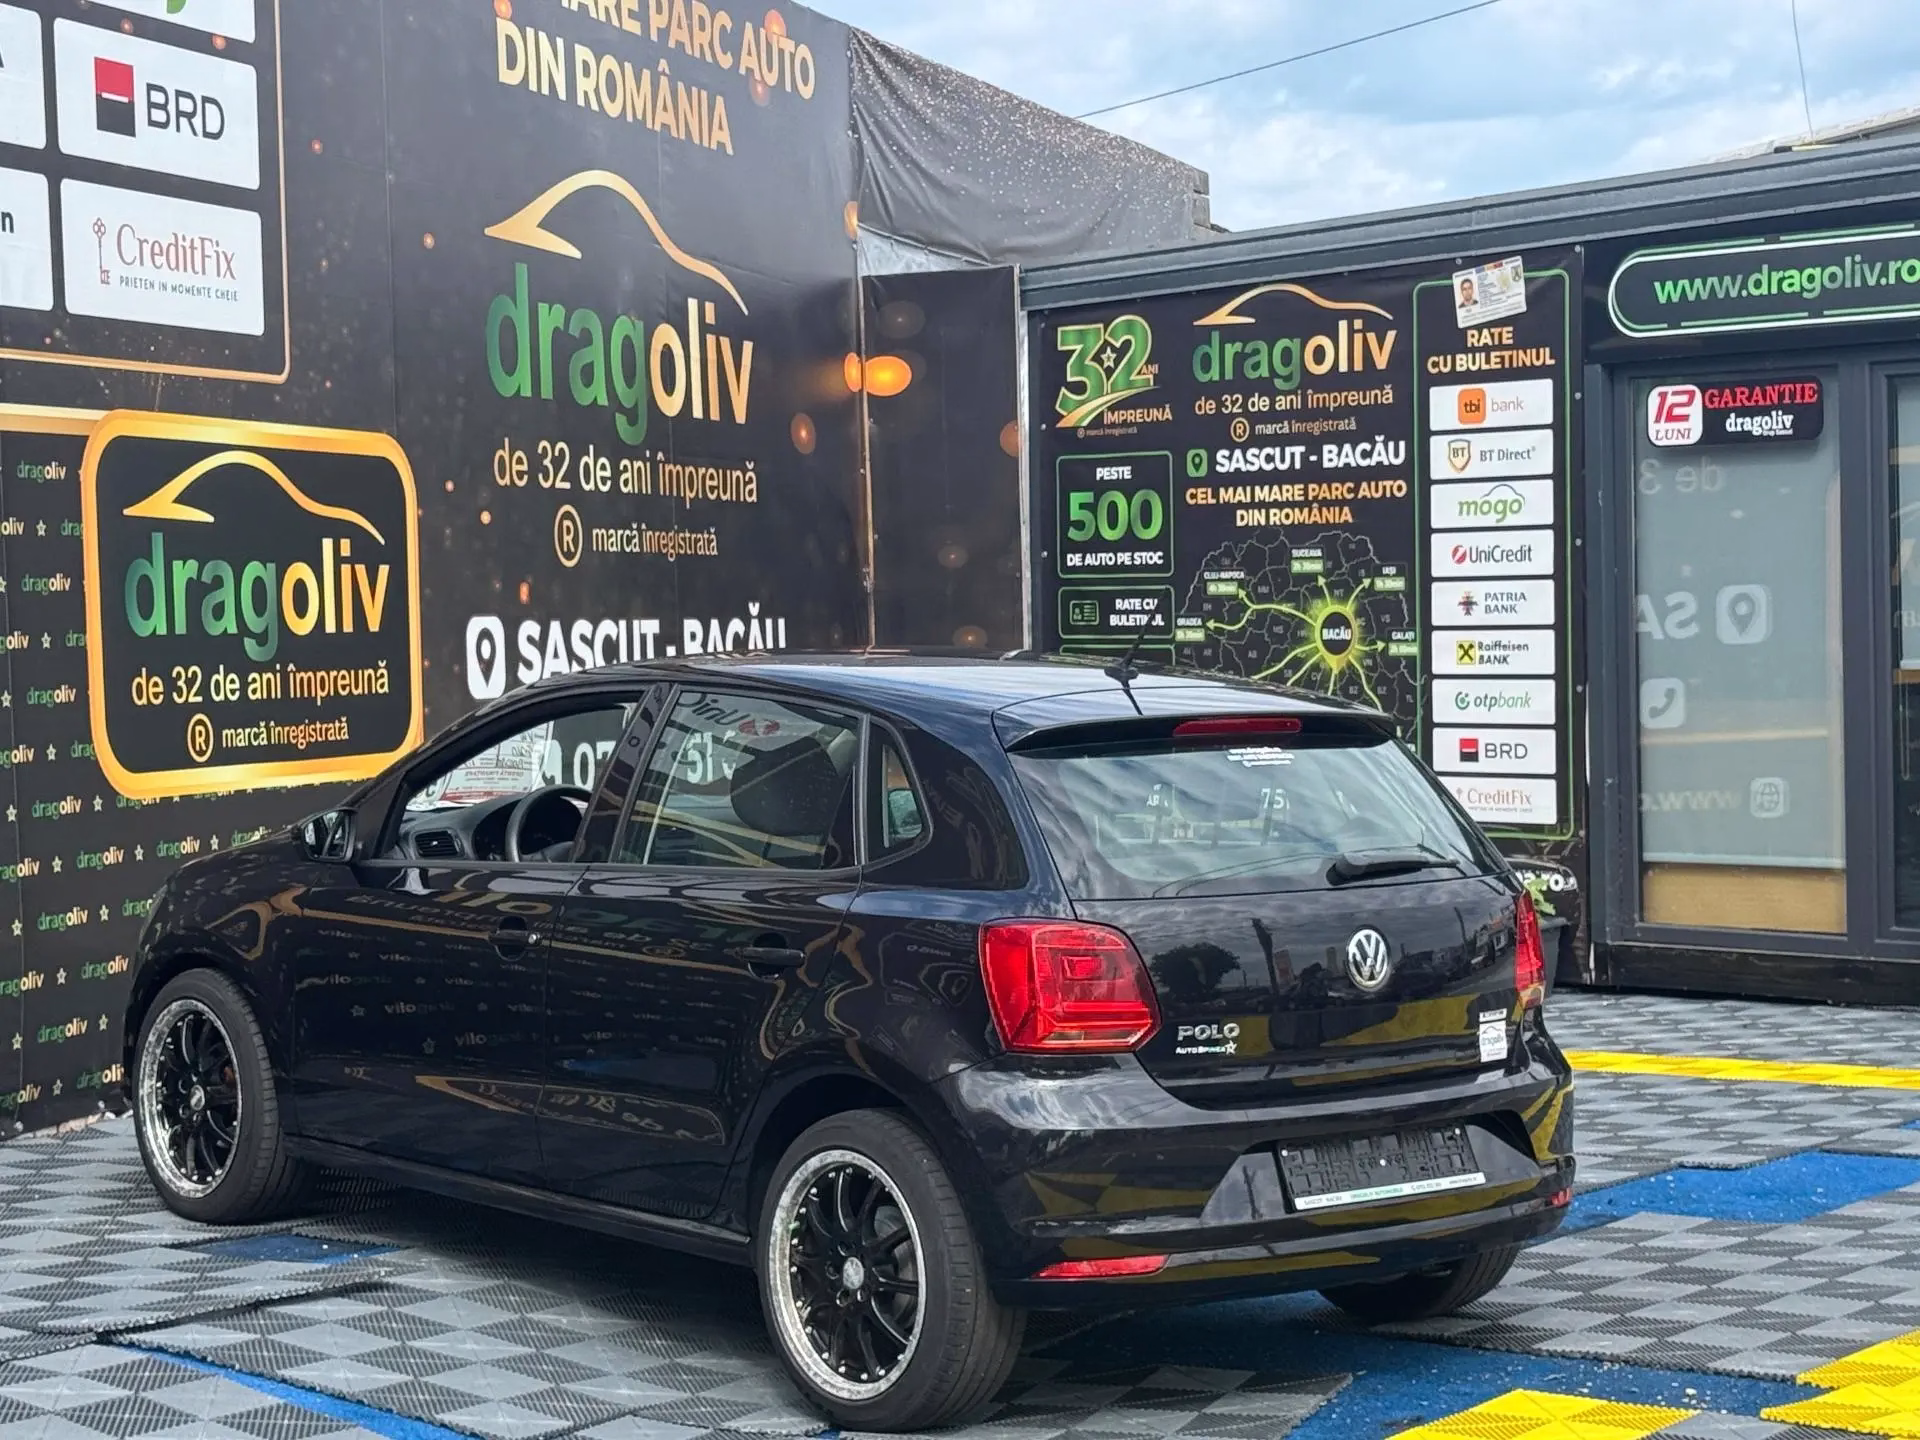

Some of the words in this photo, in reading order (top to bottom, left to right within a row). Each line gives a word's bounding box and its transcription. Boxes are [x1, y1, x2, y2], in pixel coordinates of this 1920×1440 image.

[561, 0, 642, 37] RE
[649, 0, 733, 69] PARC
[738, 21, 815, 100] AUTO
[496, 18, 567, 101] DIN
[574, 42, 734, 155] ROMÂNIA
[146, 83, 225, 141] BRD
[116, 223, 237, 281] CreditFix
[119, 275, 155, 291] PRIETEN
[158, 280, 168, 293] IN
[171, 283, 212, 299] MOMENTE
[215, 288, 238, 302] CHEIE
[1653, 254, 1920, 304] www.dragoliv.ro
[1467, 326, 1514, 348] RATE
[485, 262, 754, 446] dragoliv
[1192, 318, 1397, 390] dragoliv
[1427, 354, 1452, 375] CU
[1455, 347, 1556, 373] BULETINUL
[1141, 364, 1159, 376] ANI
[1194, 396, 1216, 415] de
[1221, 393, 1243, 413] 32
[1248, 392, 1270, 412] de
[1275, 391, 1301, 411] ani
[1307, 384, 1393, 412] împreună
[1464, 398, 1481, 414] tbi
[1491, 396, 1524, 412] bank
[1653, 389, 1697, 423] 12
[1704, 382, 1818, 409] GARANTIE
[1103, 404, 1173, 425] ÎMPREUNĂ
[1255, 420, 1290, 435] marcă
[1291, 418, 1356, 436] înregistrată
[1725, 410, 1794, 436] dragoliv
[1654, 428, 1692, 442] LUNI
[1215, 446, 1306, 474] SASCUT
[1321, 435, 1406, 470] BACĂU
[1479, 449, 1495, 462] BT
[17, 460, 67, 484] dragoliv
[494, 437, 528, 488] de
[538, 439, 571, 490] 32
[579, 444, 612, 493] de
[619, 451, 651, 496] ani
[658, 452, 758, 509] împreună
[1096, 466, 1132, 481] PESTE
[1185, 486, 1217, 505] CEL
[1219, 485, 1251, 504] MAI
[1254, 483, 1305, 503] MARE
[1307, 481, 1355, 501] PARC
[1357, 480, 1407, 499] AUTO
[1067, 488, 1164, 542] 500
[1236, 509, 1266, 527] DIN
[1269, 503, 1353, 526] ROMÂNIA
[1458, 498, 1523, 523] mogo
[592, 522, 640, 554] marcă
[641, 522, 718, 562] înregistrată
[1469, 544, 1532, 564] UniCredit
[1066, 553, 1083, 567] DE
[1084, 553, 1115, 567] AUTO
[1117, 552, 1132, 566] PE
[1133, 551, 1164, 566] STOC
[21, 573, 71, 596] dragoliv
[124, 532, 390, 662] dragoliv
[1115, 598, 1142, 611] RATE
[1484, 592, 1527, 603] PATRIA
[1484, 603, 1518, 614] BANK
[1322, 627, 1352, 641] BACĂU
[1478, 640, 1529, 652] Raiffeisen
[516, 618, 660, 686] SASCUT
[1478, 655, 1510, 665] BANK
[132, 667, 164, 706] de
[172, 665, 203, 704] 32
[211, 664, 239, 702] de
[247, 664, 281, 700] ani
[287, 660, 389, 706] împreună
[26, 684, 76, 708] dragoliv
[1474, 691, 1531, 711] otpbank
[222, 719, 268, 748] marcă
[269, 716, 349, 750] înregistrată
[1484, 743, 1528, 760] BRD
[32, 795, 82, 820] dragoliv
[1467, 788, 1532, 805] CreditFix
[76, 846, 125, 871] dragoliv
[156, 837, 200, 859] dragoliv
[37, 906, 89, 933] dragoliv
[81, 954, 129, 980] dragoliv
[37, 1017, 88, 1043] dragoliv
[1177, 1022, 1240, 1041] POLO
